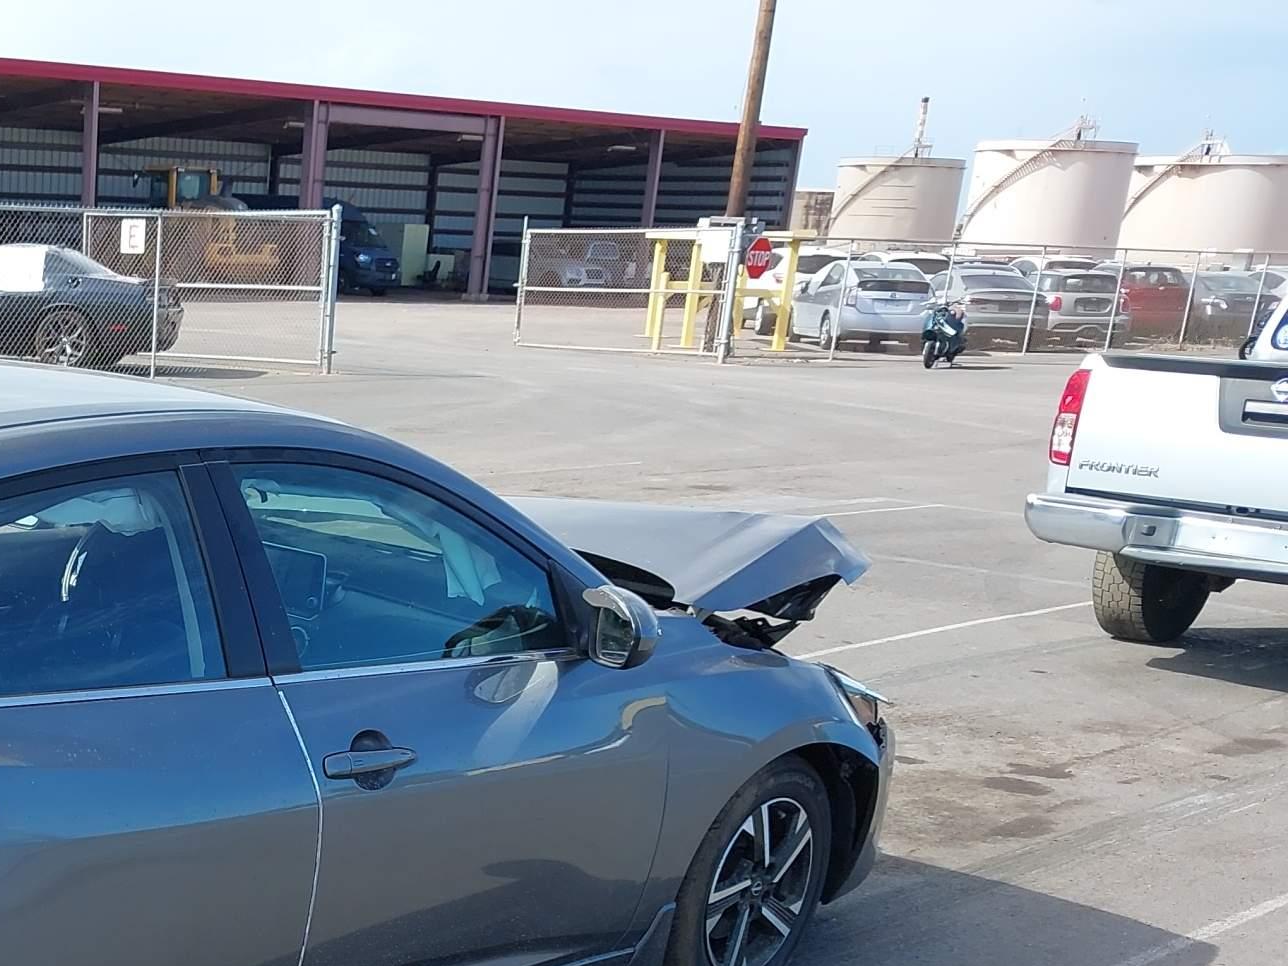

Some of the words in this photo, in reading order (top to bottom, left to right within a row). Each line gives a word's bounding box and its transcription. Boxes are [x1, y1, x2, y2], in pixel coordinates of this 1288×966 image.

[128, 224, 140, 249] E
[747, 250, 771, 267] STOP
[1078, 459, 1160, 478] FRONTIER
